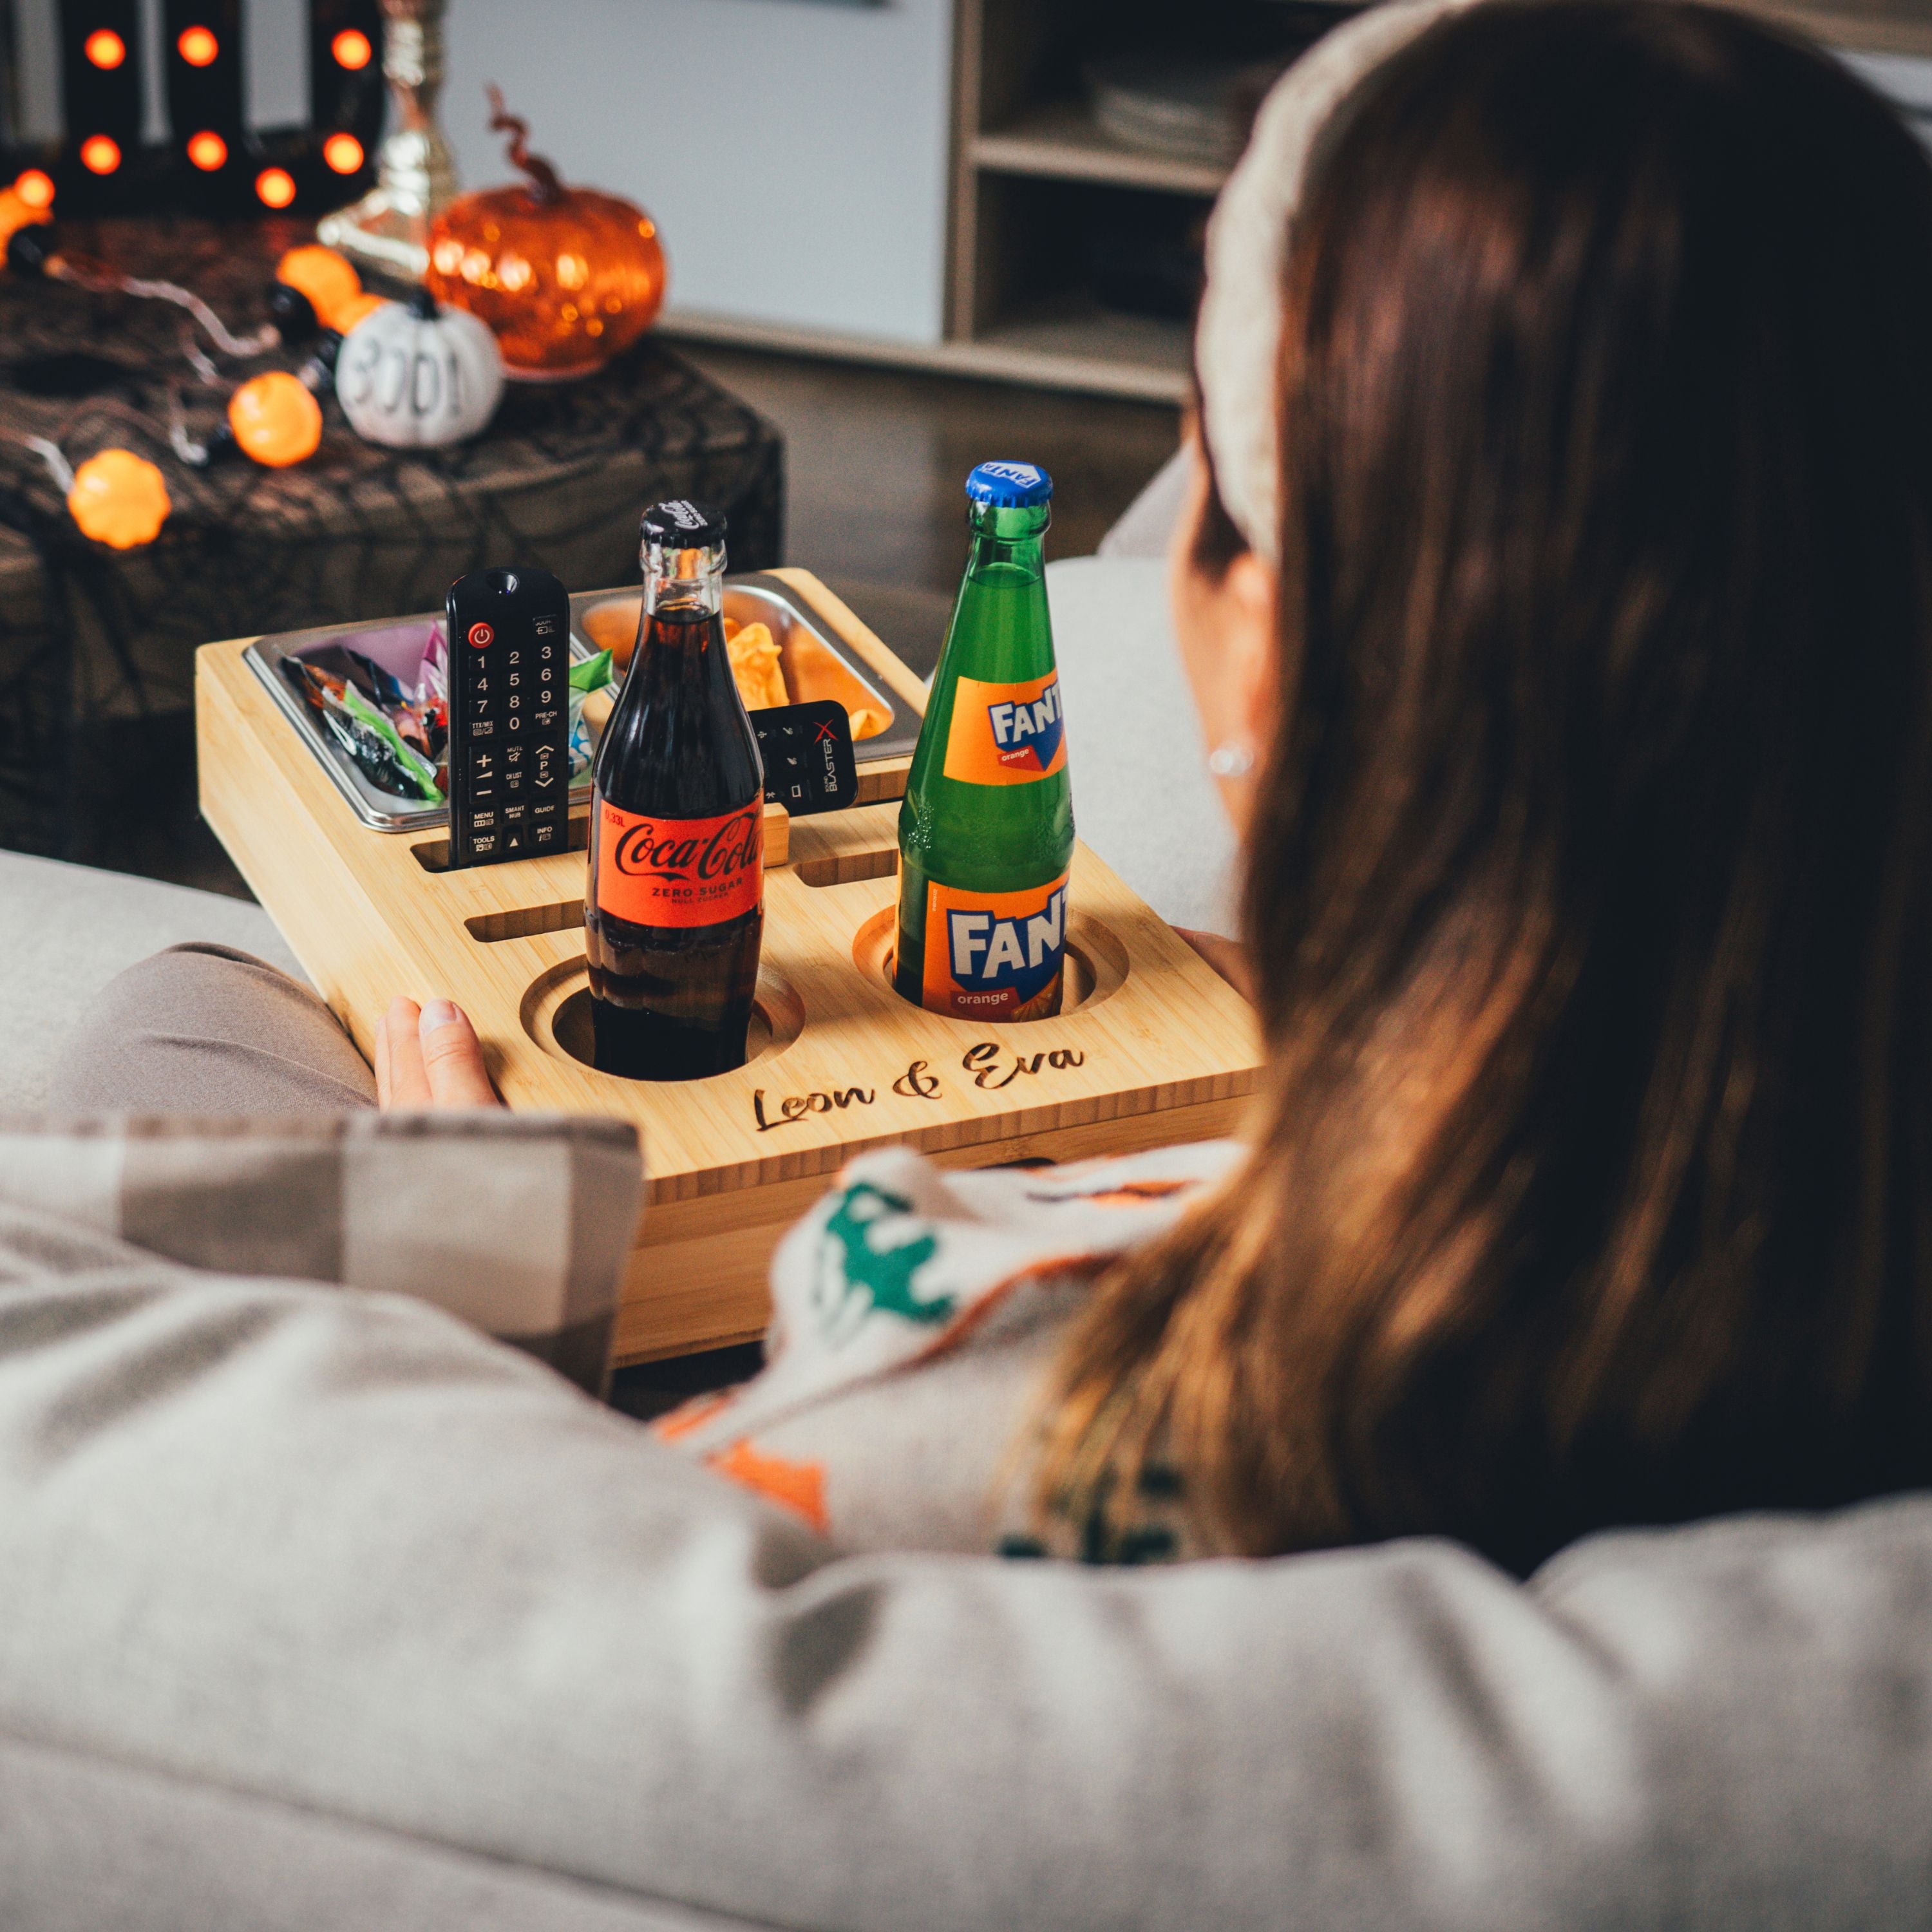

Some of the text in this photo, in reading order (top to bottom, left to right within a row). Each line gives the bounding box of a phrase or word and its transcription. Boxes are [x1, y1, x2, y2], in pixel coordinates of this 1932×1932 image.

[984, 463, 1036, 485] FANTA
[509, 651, 520, 664] 2
[542, 646, 552, 659] 3
[478, 656, 485, 668] 1
[509, 673, 520, 686] 5
[541, 668, 552, 681] 6
[477, 677, 488, 691] 4
[509, 696, 520, 708] 8
[541, 690, 552, 703] 9
[477, 700, 488, 713] 7
[535, 711, 557, 719] PRE-CH
[509, 717, 520, 730] 0
[1001, 748, 1029, 762] orange
[540, 761, 548, 770] P
[474, 811, 493, 820] MENU
[505, 806, 524, 814] SMART
[535, 805, 554, 813] GUIDE
[473, 836, 495, 845] TOOLS
[615, 811, 758, 881] Coca-Cola
[652, 877, 743, 898] ZERO SUGAR
[951, 889, 1065, 978] FAN
[958, 993, 1009, 1005] orange
[753, 1042, 1084, 1132] Leon & Eva
